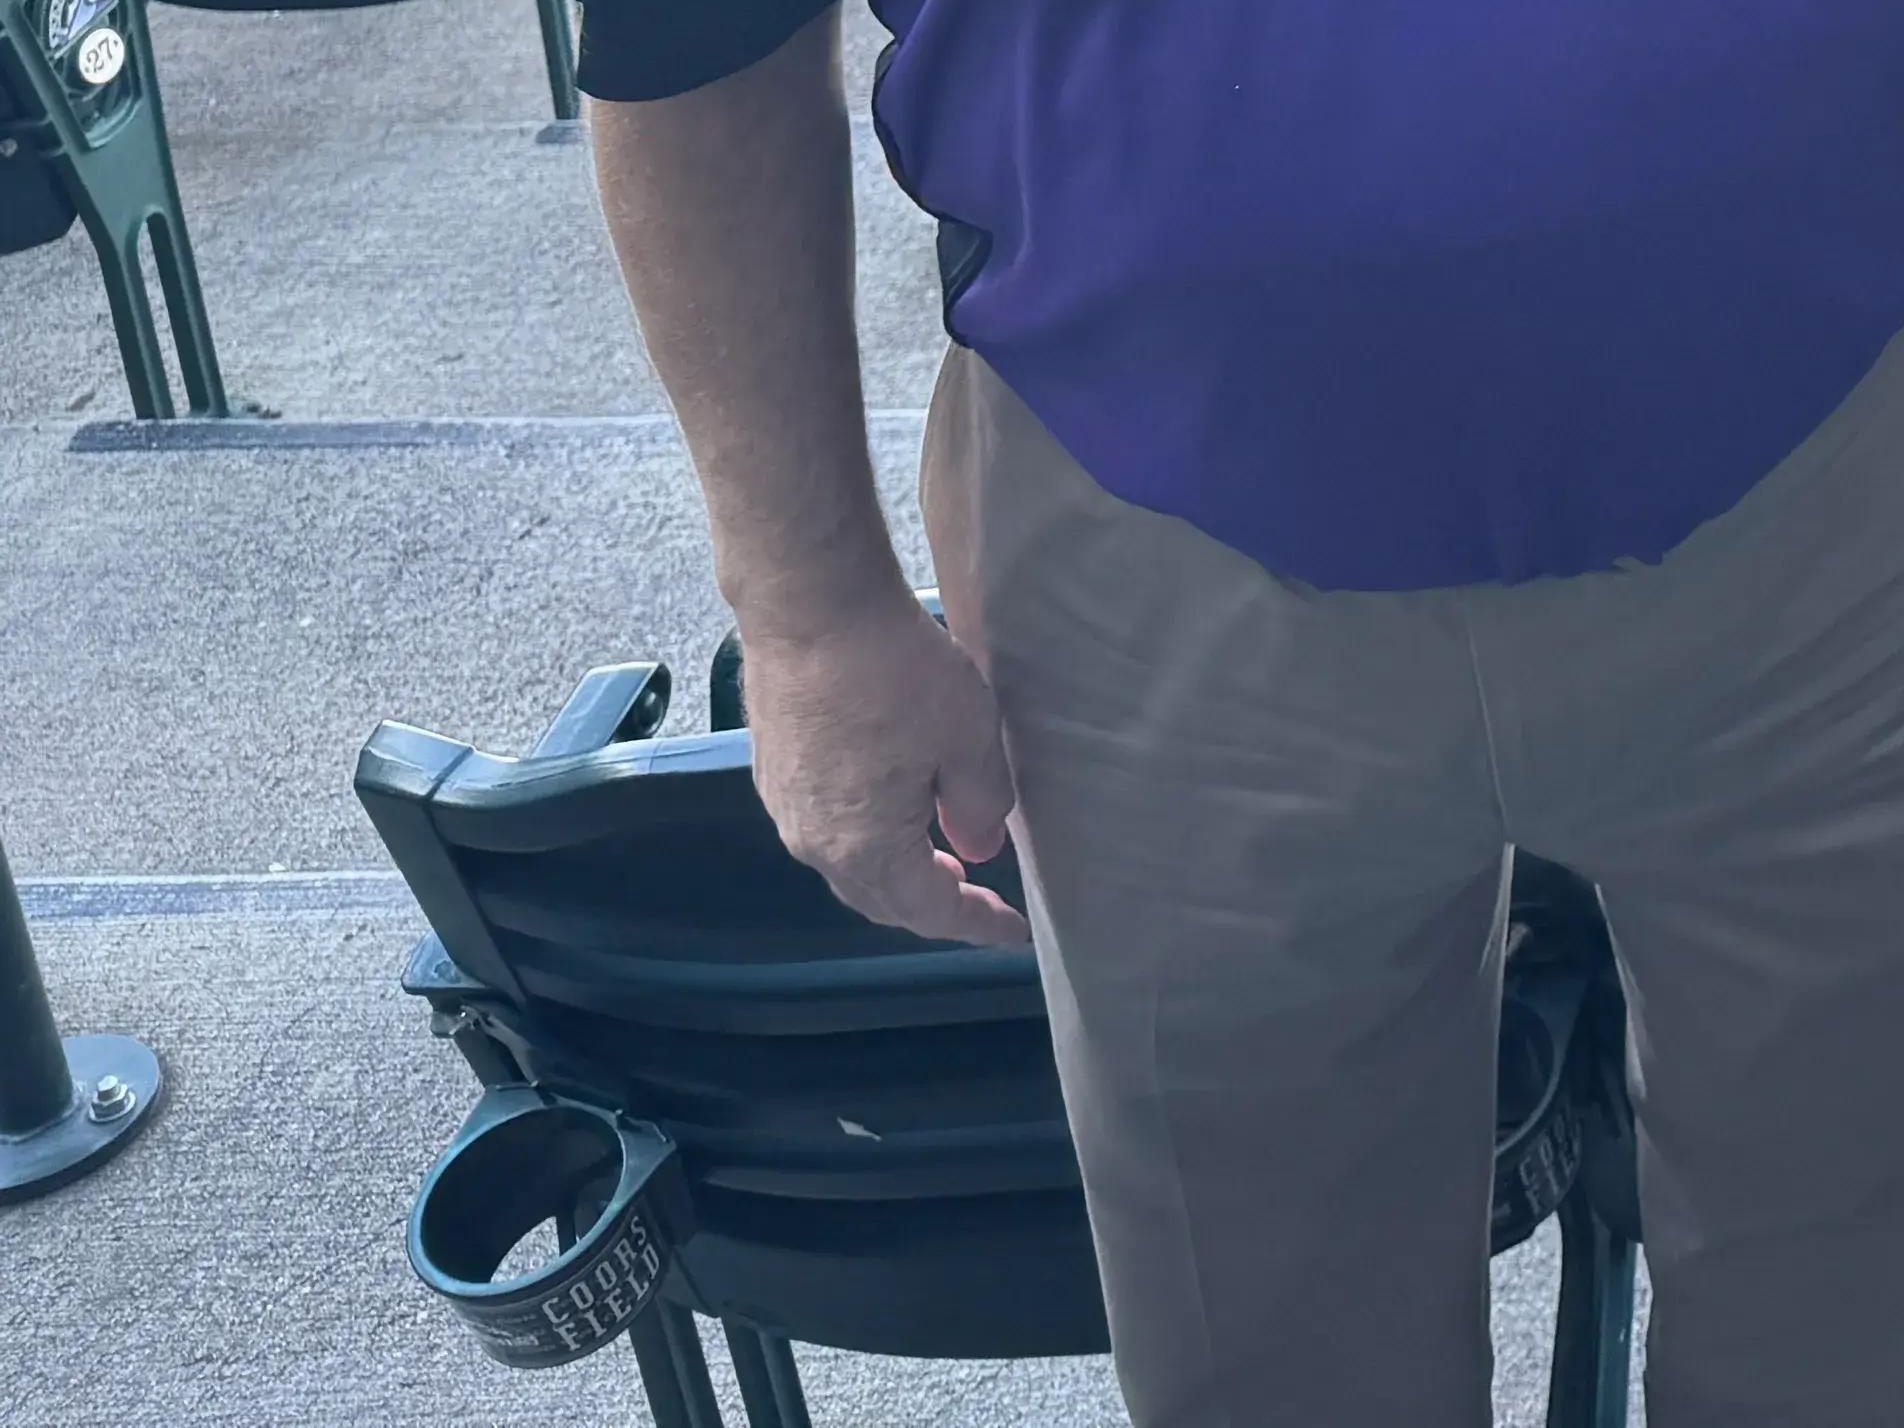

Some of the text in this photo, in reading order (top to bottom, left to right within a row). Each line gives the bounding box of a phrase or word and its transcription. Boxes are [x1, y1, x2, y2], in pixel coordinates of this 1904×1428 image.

[85, 36, 113, 74] 27
[540, 1215, 648, 1326] COORS
[556, 1242, 660, 1352] FIELD
